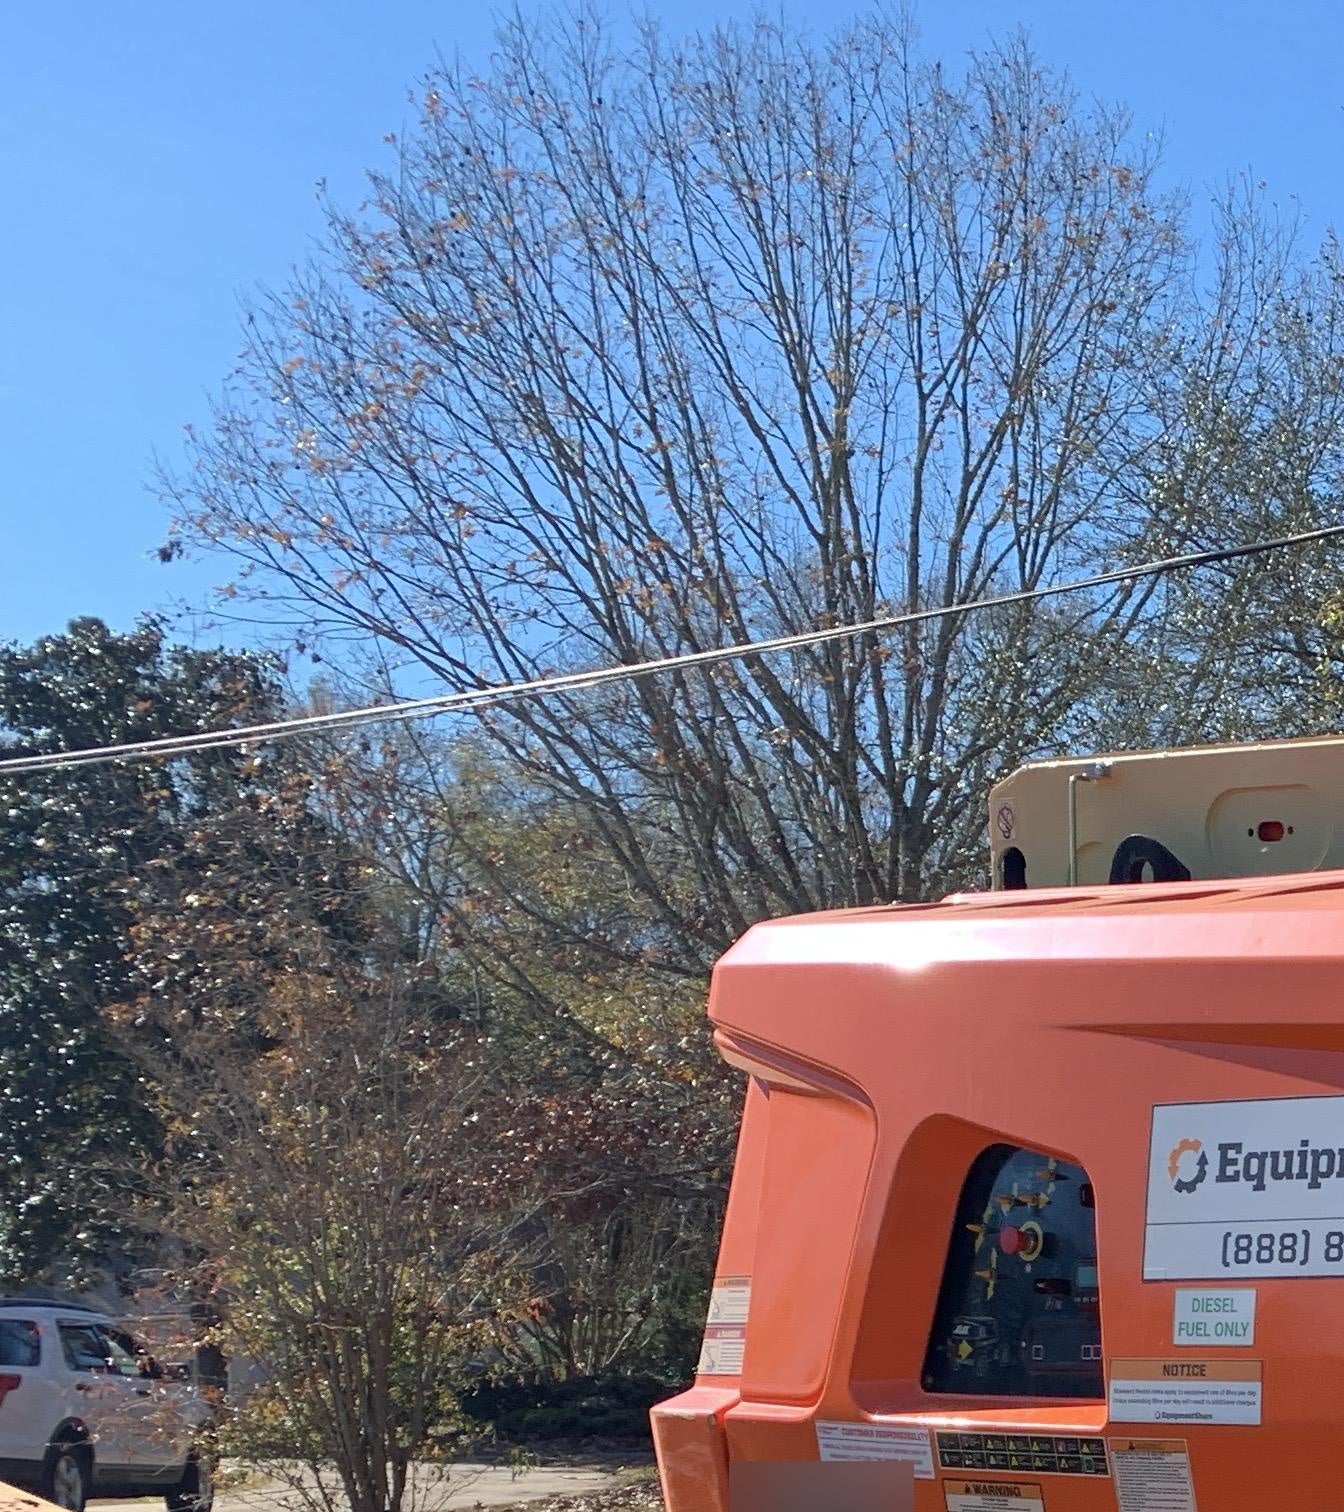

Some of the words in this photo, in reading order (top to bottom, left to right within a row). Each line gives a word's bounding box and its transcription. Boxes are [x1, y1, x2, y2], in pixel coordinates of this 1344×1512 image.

[1221, 1232, 1310, 1267] (888)
[1191, 1297, 1238, 1315] DIESEL
[1178, 1321, 1211, 1338] FUEL
[1214, 1321, 1249, 1338] ONLY
[1162, 1364, 1207, 1377] NOTICE
